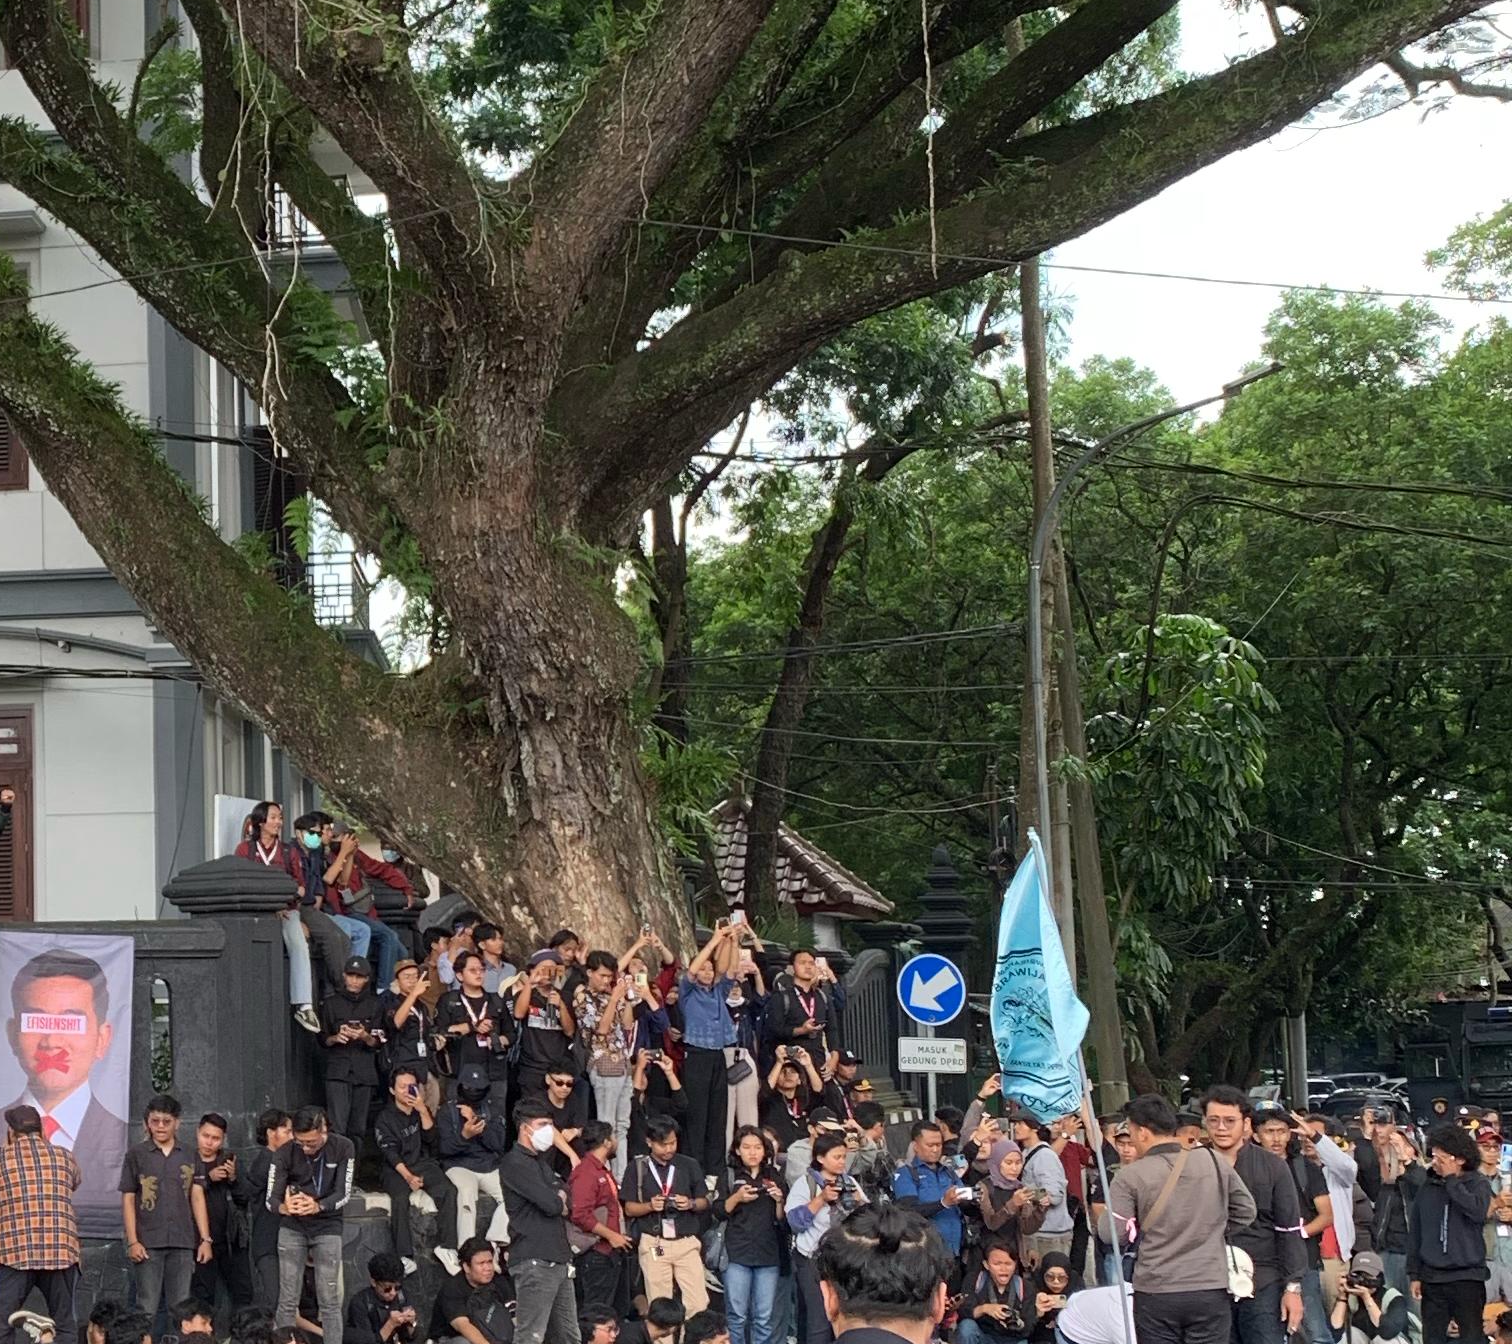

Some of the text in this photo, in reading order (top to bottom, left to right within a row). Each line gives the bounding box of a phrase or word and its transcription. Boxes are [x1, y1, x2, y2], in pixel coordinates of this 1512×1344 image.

[917, 1046, 948, 1054] MASUK
[901, 1056, 964, 1066] GEDUNG DPRD
